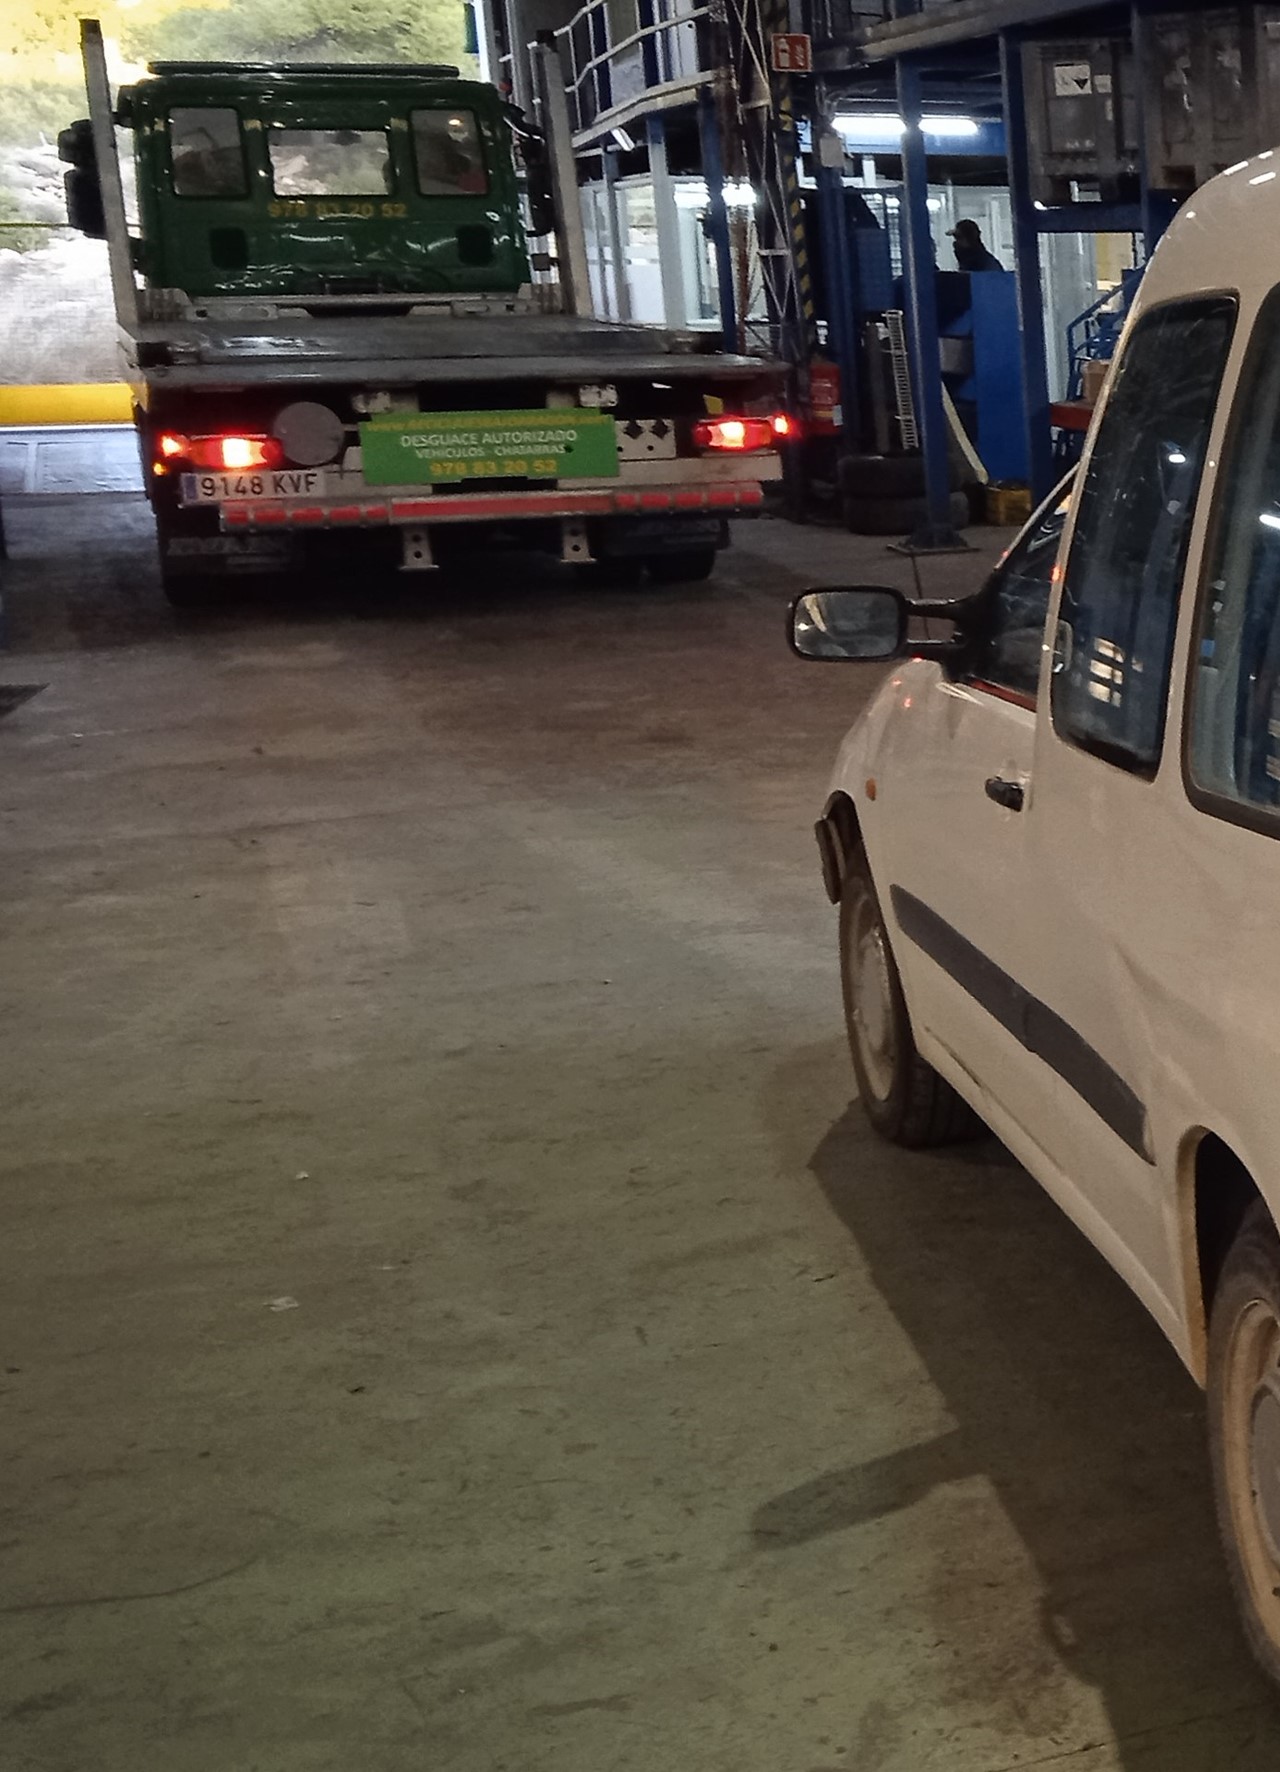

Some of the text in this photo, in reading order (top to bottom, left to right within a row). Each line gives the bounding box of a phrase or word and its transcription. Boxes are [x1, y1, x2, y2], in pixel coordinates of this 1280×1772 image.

[400, 429, 578, 448] DESGUACE AUTORIZADO
[429, 459, 558, 476] 978 83 20 52
[200, 472, 318, 497] 9148 KVF
